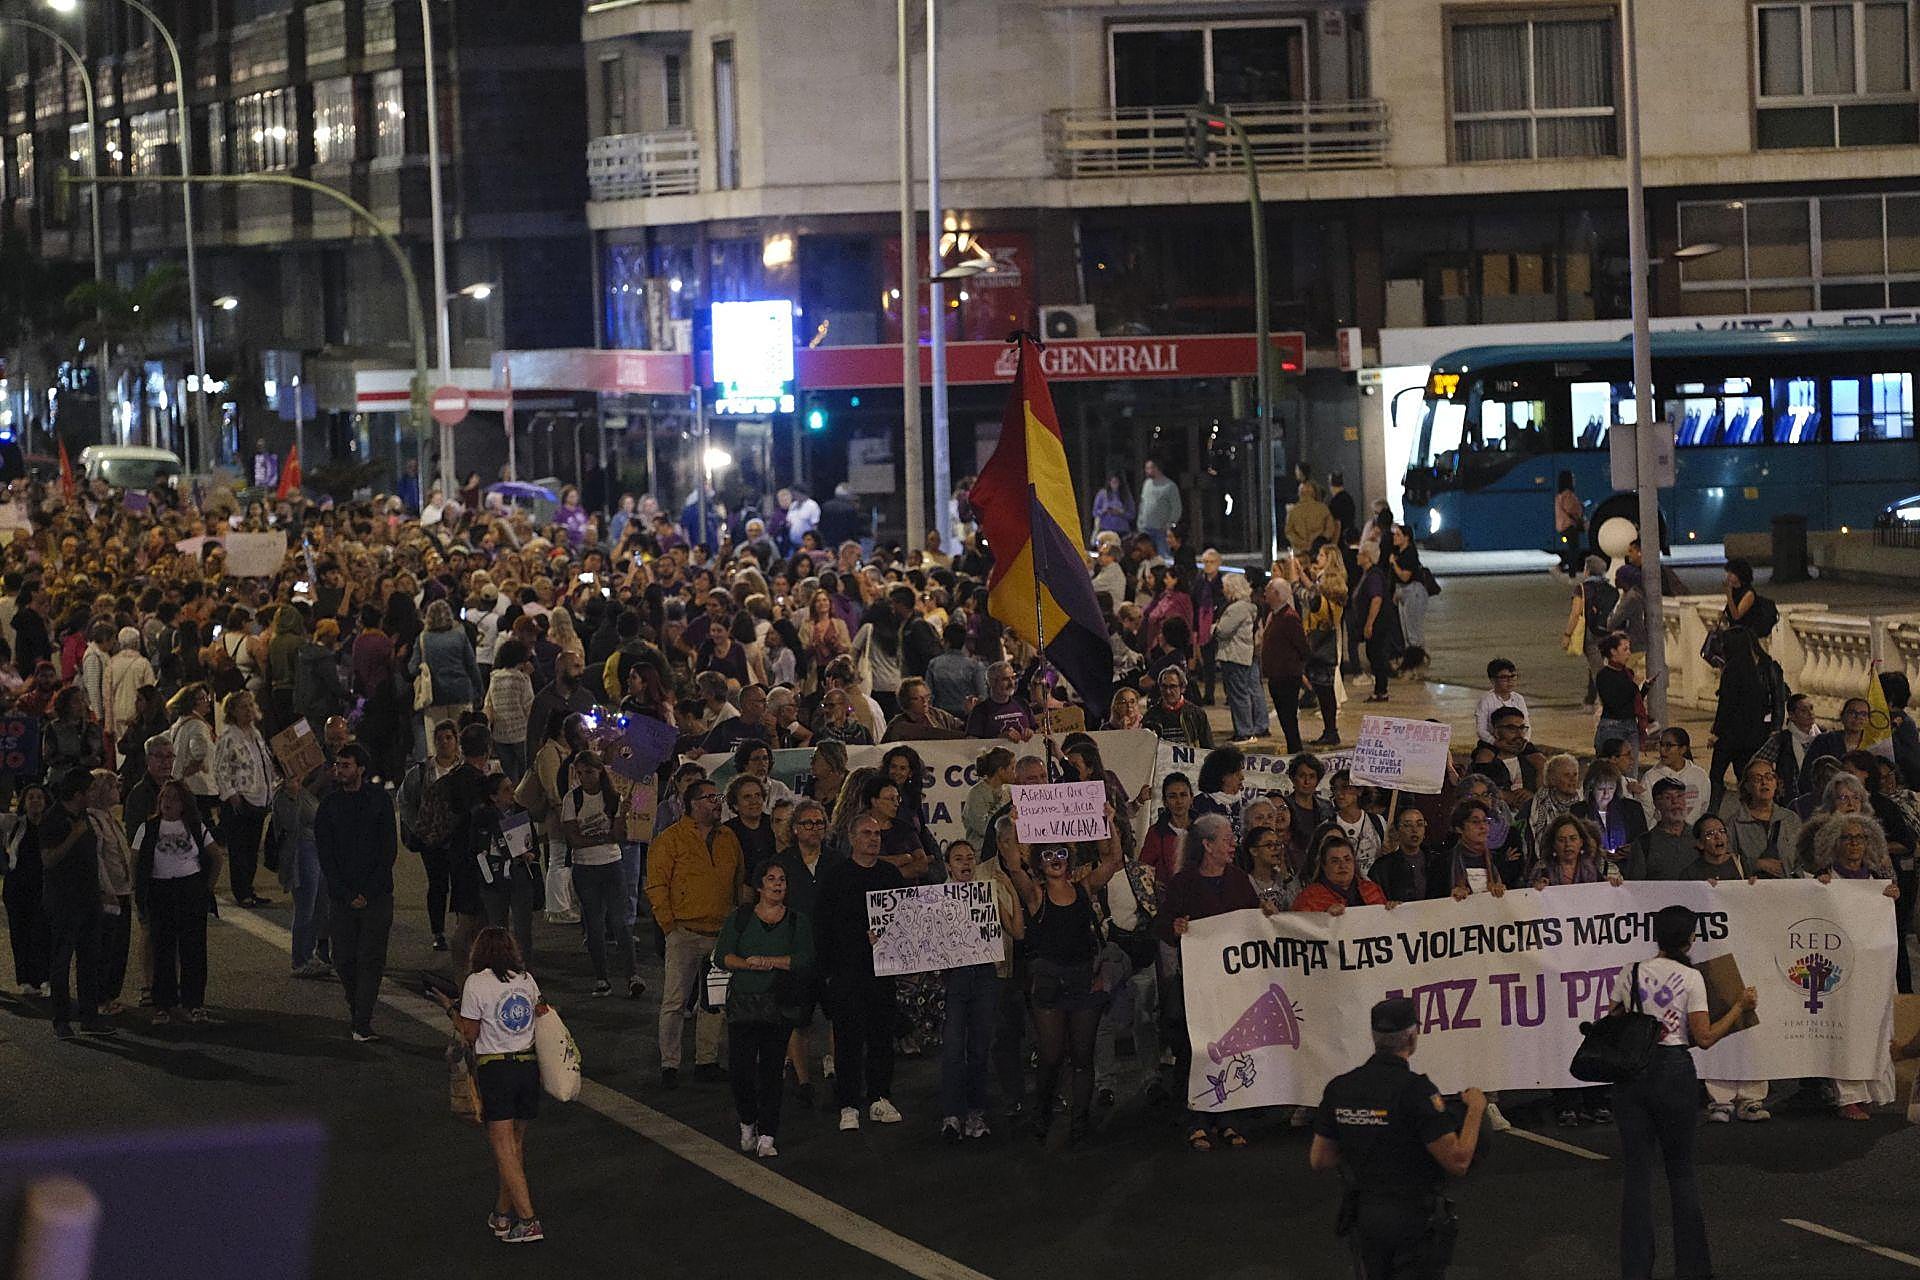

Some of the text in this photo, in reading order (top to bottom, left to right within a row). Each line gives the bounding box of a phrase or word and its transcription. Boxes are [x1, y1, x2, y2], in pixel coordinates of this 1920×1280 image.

[1039, 344, 1180, 374] GENERALI
[1375, 739, 1384, 748] EL
[1172, 745, 1195, 764] NI
[1368, 756, 1377, 765] TE
[1222, 936, 1329, 976] CONTRA
[1338, 935, 1393, 971] LAS
[1396, 917, 1563, 965] VIOLENCIAS
[1789, 932, 1842, 951] RED
[1488, 972, 1546, 1028] TU
